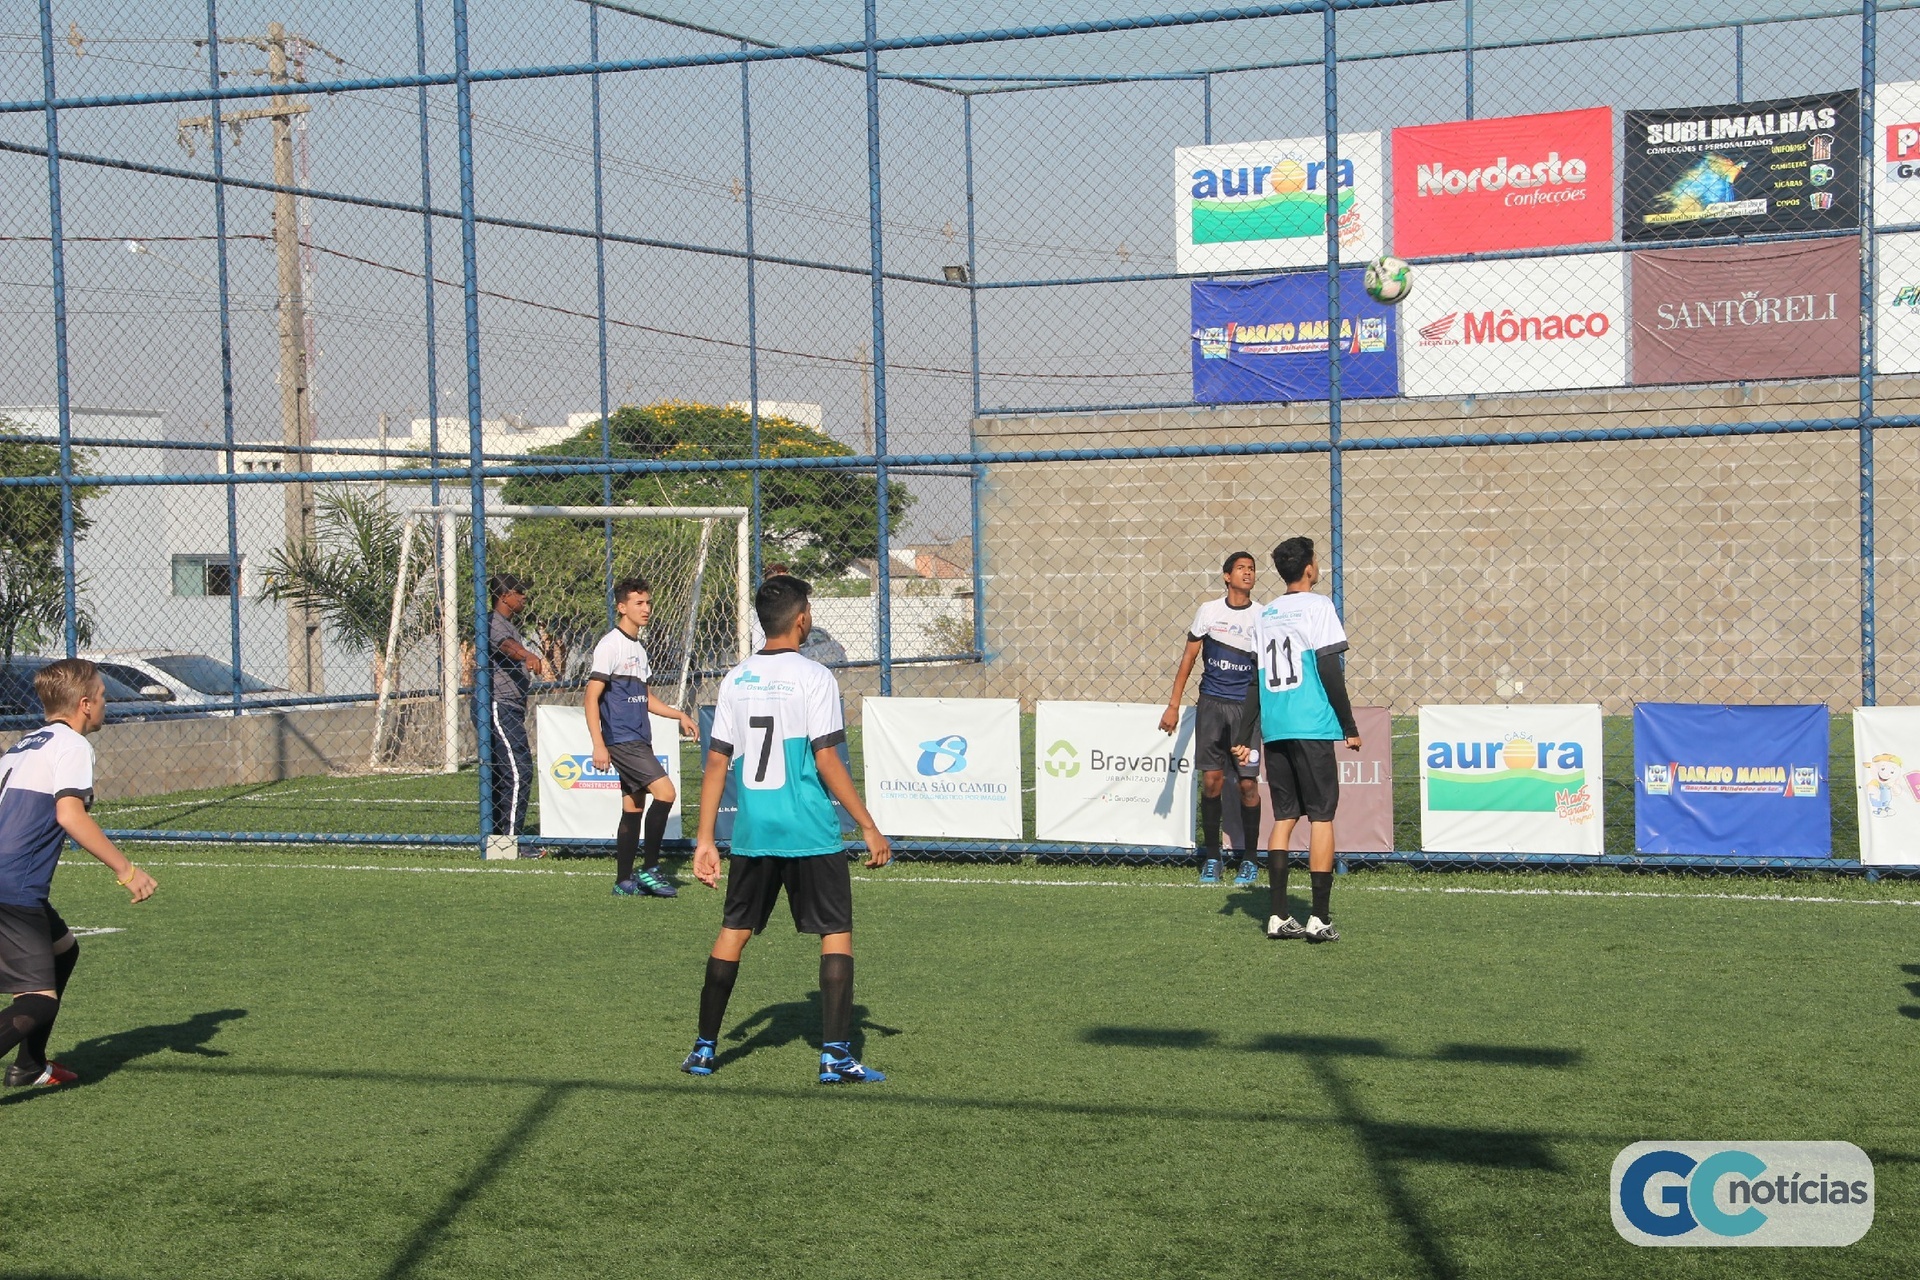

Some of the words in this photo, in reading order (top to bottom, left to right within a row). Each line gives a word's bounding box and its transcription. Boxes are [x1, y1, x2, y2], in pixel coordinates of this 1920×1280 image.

[1647, 108, 1836, 145] SUBLIMALHAS
[1704, 139, 1773, 151] PERSONALIZADOS
[1771, 143, 1807, 154] UNIFORMES
[1897, 128, 1920, 157] P
[1770, 161, 1807, 170] CAMISETAS
[1191, 158, 1354, 199] aurora
[1417, 152, 1587, 197] Nordeste
[1504, 187, 1587, 208] Confecções
[1776, 199, 1800, 207] COPOS
[1657, 292, 1839, 331] SANTORELI
[1464, 309, 1609, 345] Mônaco
[1419, 338, 1460, 347] HONDA
[1266, 636, 1298, 687] 11
[1504, 731, 1534, 743] CASA
[749, 716, 775, 783] 7
[1427, 741, 1583, 770] aurora
[1091, 749, 1190, 774] Bravante
[1650, 765, 1666, 774] TOP
[1677, 766, 1734, 784] BARATO
[1736, 766, 1786, 783] MANIA
[1797, 768, 1813, 777] TOP
[578, 781, 618, 790] CONSTRUÇÃO
[1105, 775, 1166, 783] URBANIZADORA
[1653, 774, 1664, 783] 20
[1800, 777, 1812, 786] 20
[880, 778, 928, 792] CLÍNICA
[931, 780, 956, 793] SÃO
[959, 782, 1007, 794] CAMILO
[880, 792, 909, 800] CENTRO
[919, 793, 964, 801] DIAGNÓSTICO
